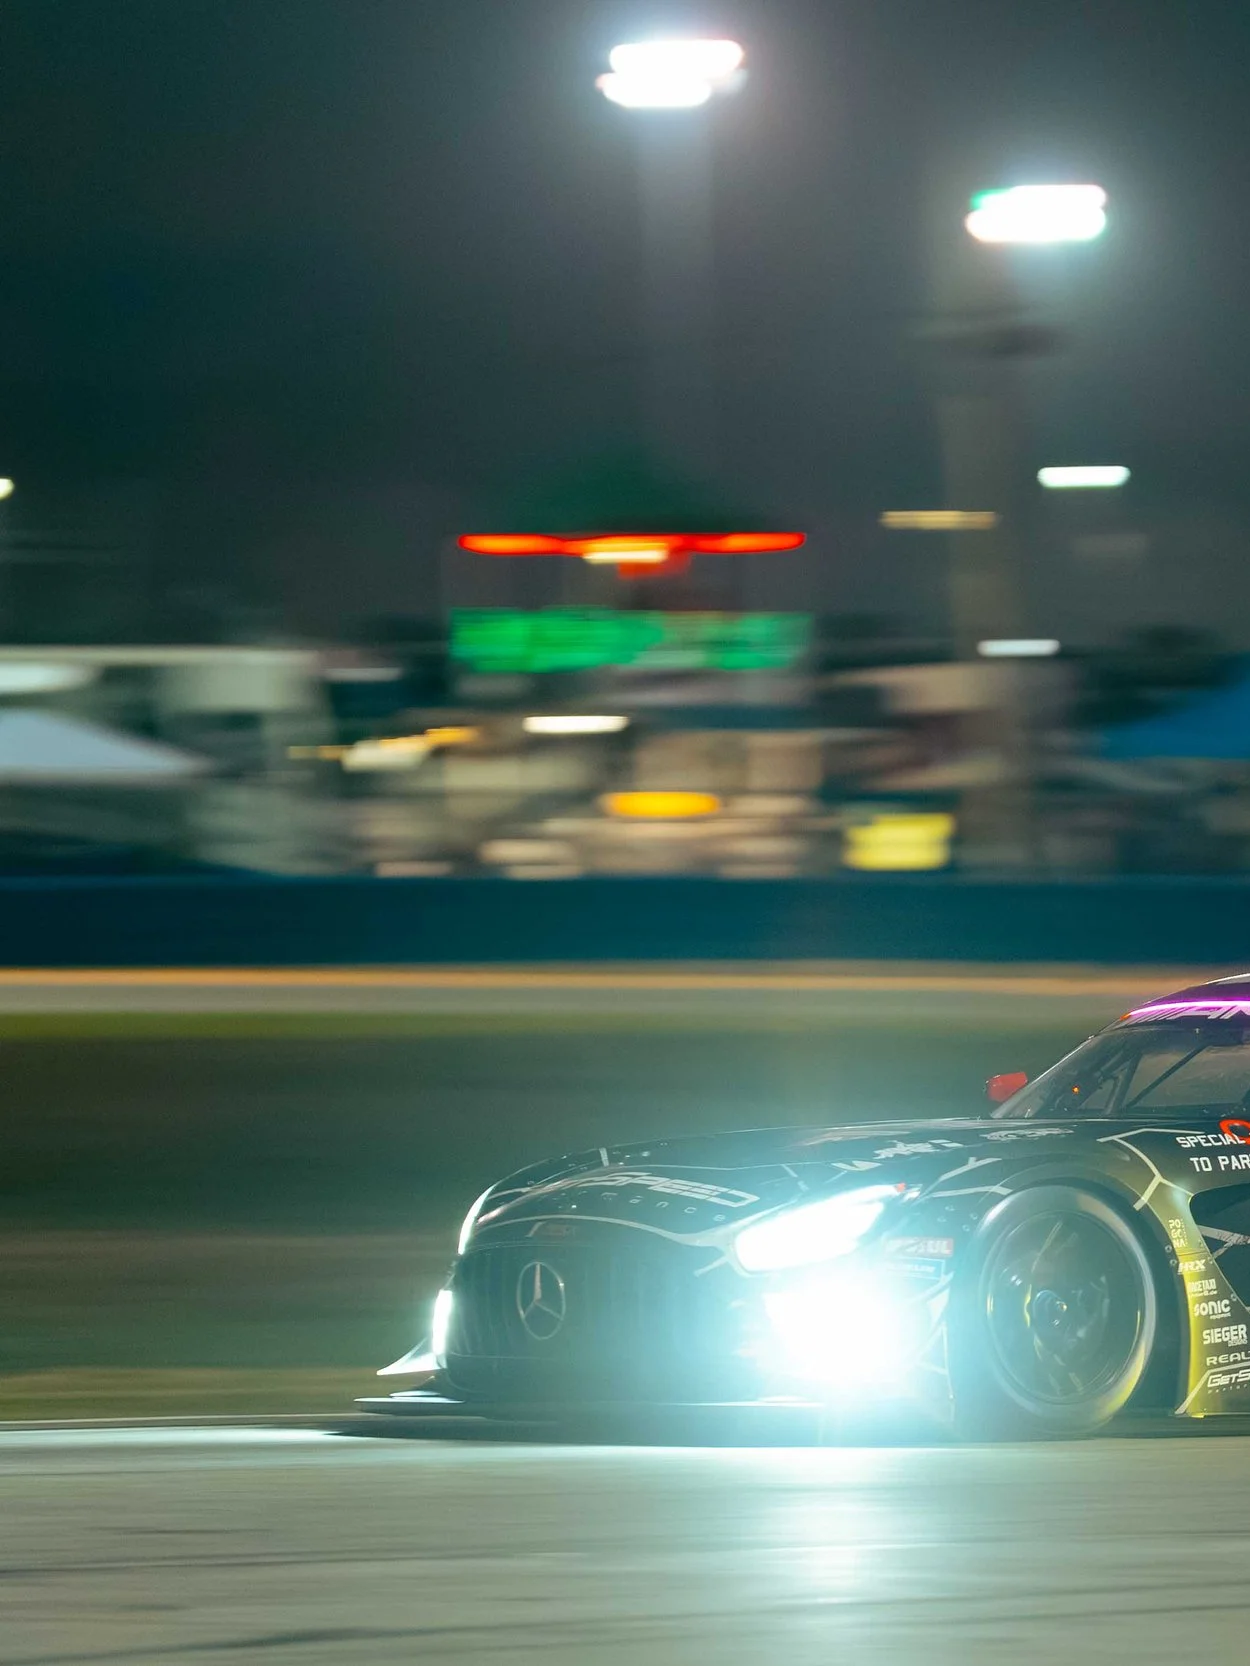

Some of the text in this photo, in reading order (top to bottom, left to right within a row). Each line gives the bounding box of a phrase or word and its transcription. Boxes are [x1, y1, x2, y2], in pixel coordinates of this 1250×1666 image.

[1176, 1131, 1246, 1148] SPECIAL
[1190, 1156, 1213, 1172] TO
[1203, 1324, 1247, 1345] SIEGER
